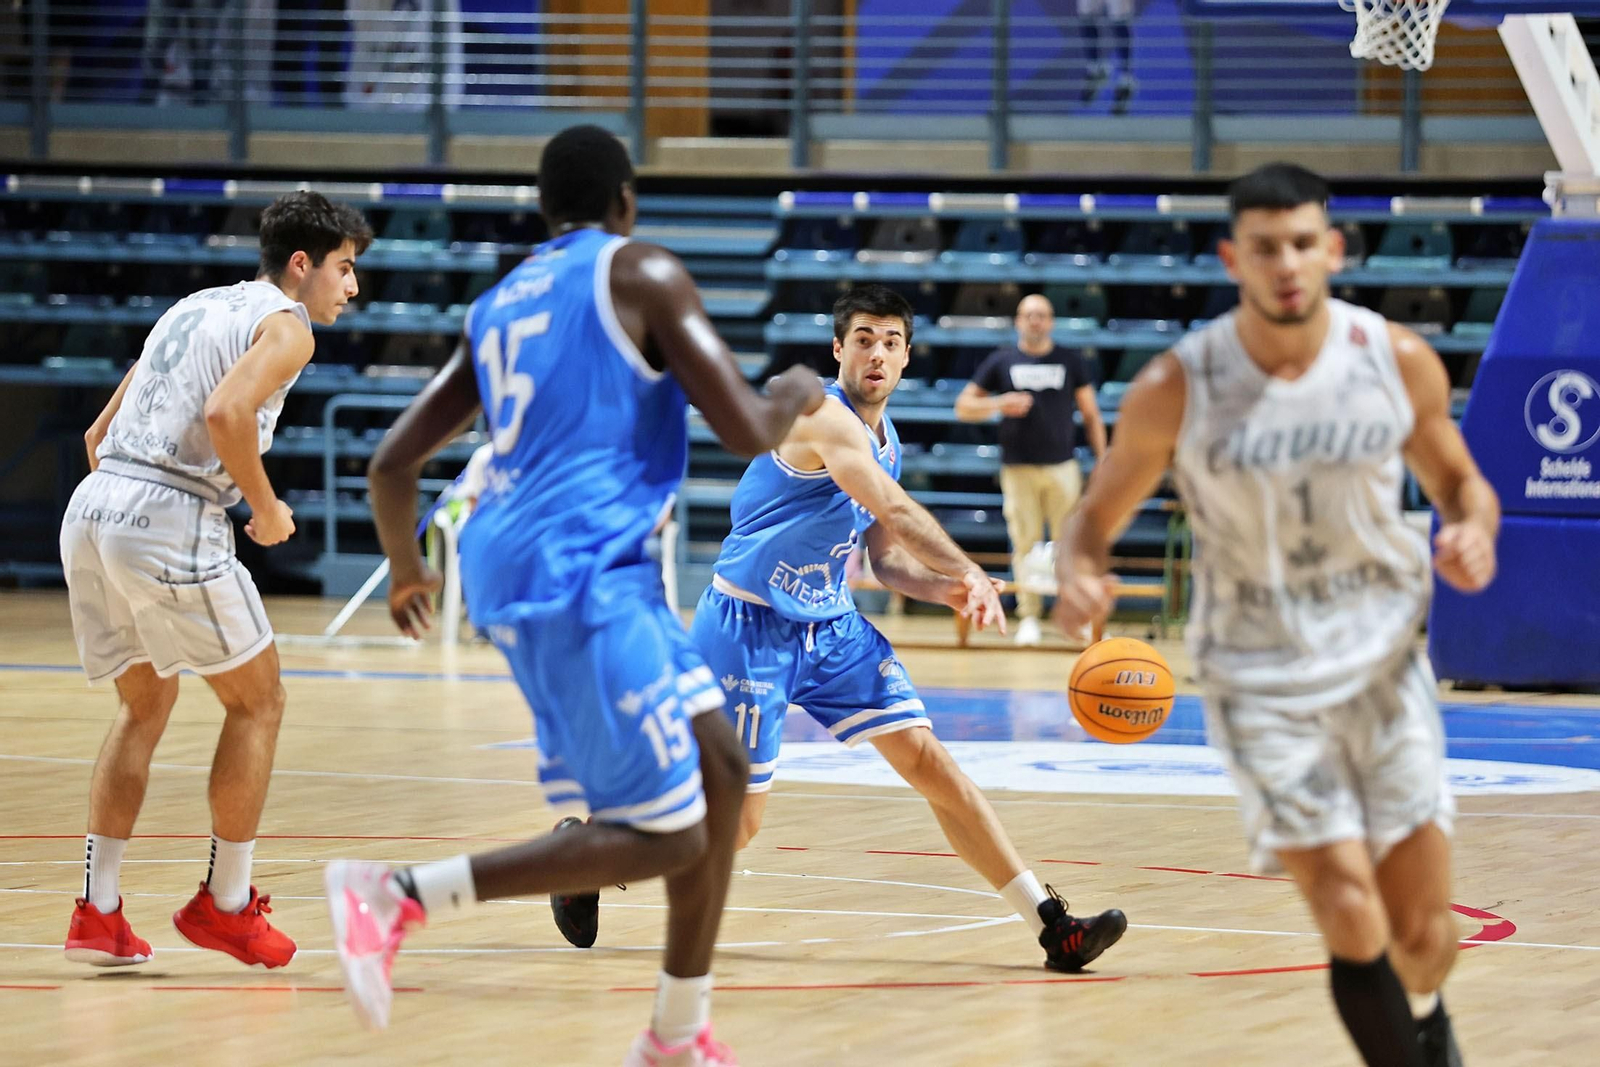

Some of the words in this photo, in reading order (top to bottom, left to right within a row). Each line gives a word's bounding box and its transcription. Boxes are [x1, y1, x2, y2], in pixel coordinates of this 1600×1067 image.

[150, 307, 206, 374] 8
[477, 310, 553, 455] 15
[1294, 478, 1311, 524] 1
[1525, 476, 1600, 499] Internationa
[640, 695, 691, 769] 15
[735, 702, 760, 749] 11
[1098, 702, 1164, 726] Wilson
